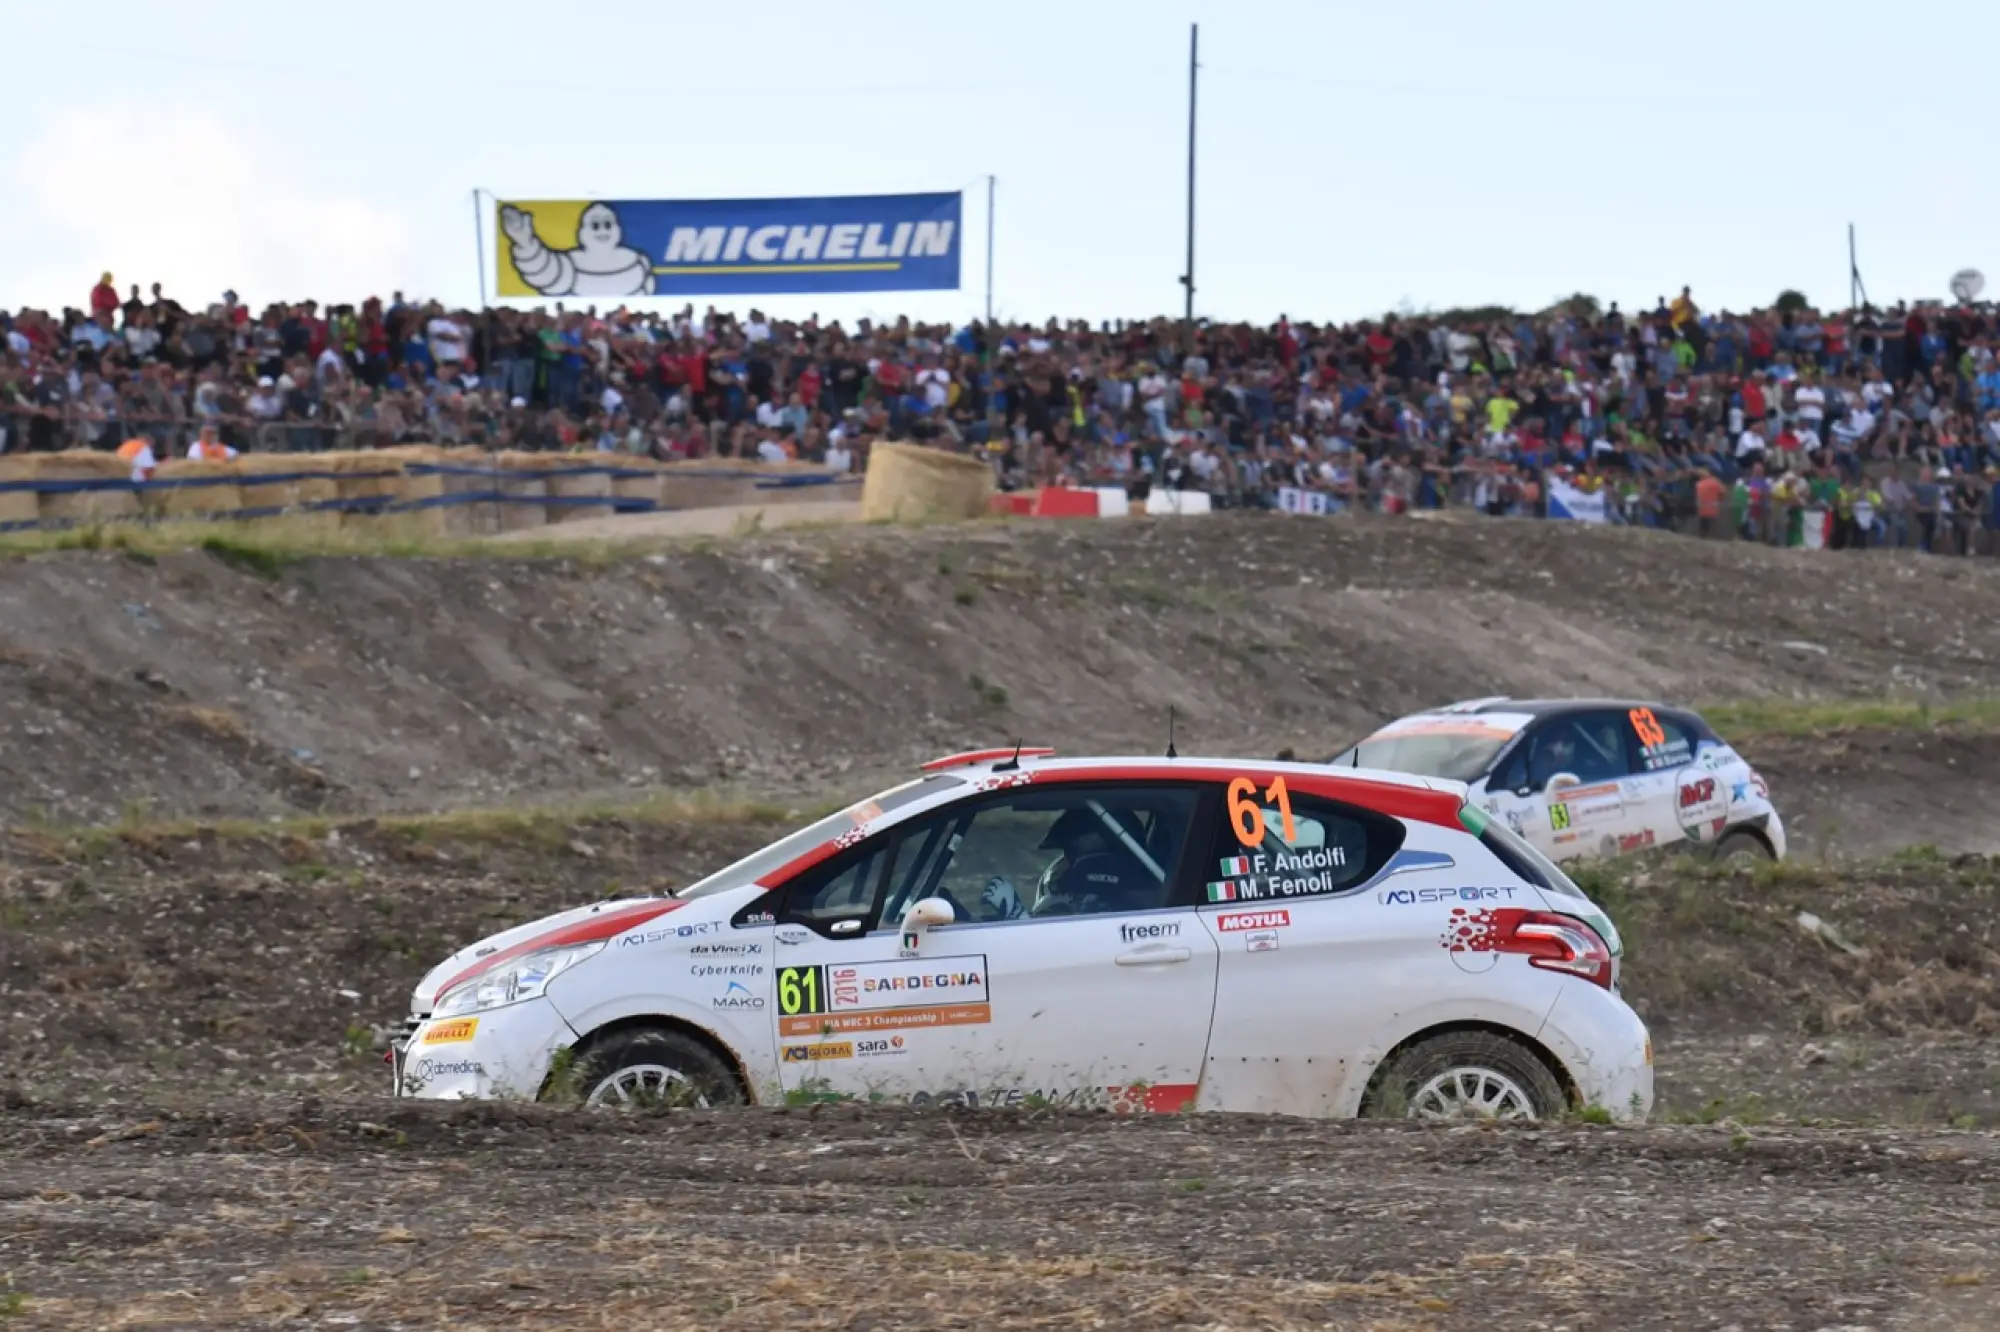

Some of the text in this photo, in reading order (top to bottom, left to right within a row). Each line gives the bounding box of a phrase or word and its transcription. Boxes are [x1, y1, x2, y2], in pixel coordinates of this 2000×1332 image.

[665, 221, 954, 262] MICHELIN
[1629, 706, 1665, 747] 63
[1228, 775, 1297, 848] 61
[1253, 846, 1346, 874] F. Andolfi
[1240, 871, 1333, 899] M. Fenoli
[1119, 921, 1180, 942] freem
[1223, 912, 1287, 930] MOTUL
[690, 964, 764, 977] CyberKnife
[780, 967, 817, 1014] 61
[833, 968, 859, 1006] 2016
[863, 972, 981, 993] SARDEGNA
[713, 997, 765, 1008] MAKO
[842, 1017, 863, 1028] WRC
[864, 1017, 871, 1026] 3
[873, 1013, 936, 1026] Championship
[425, 1022, 472, 1041] PIRELLI
[857, 1040, 888, 1052] sara
